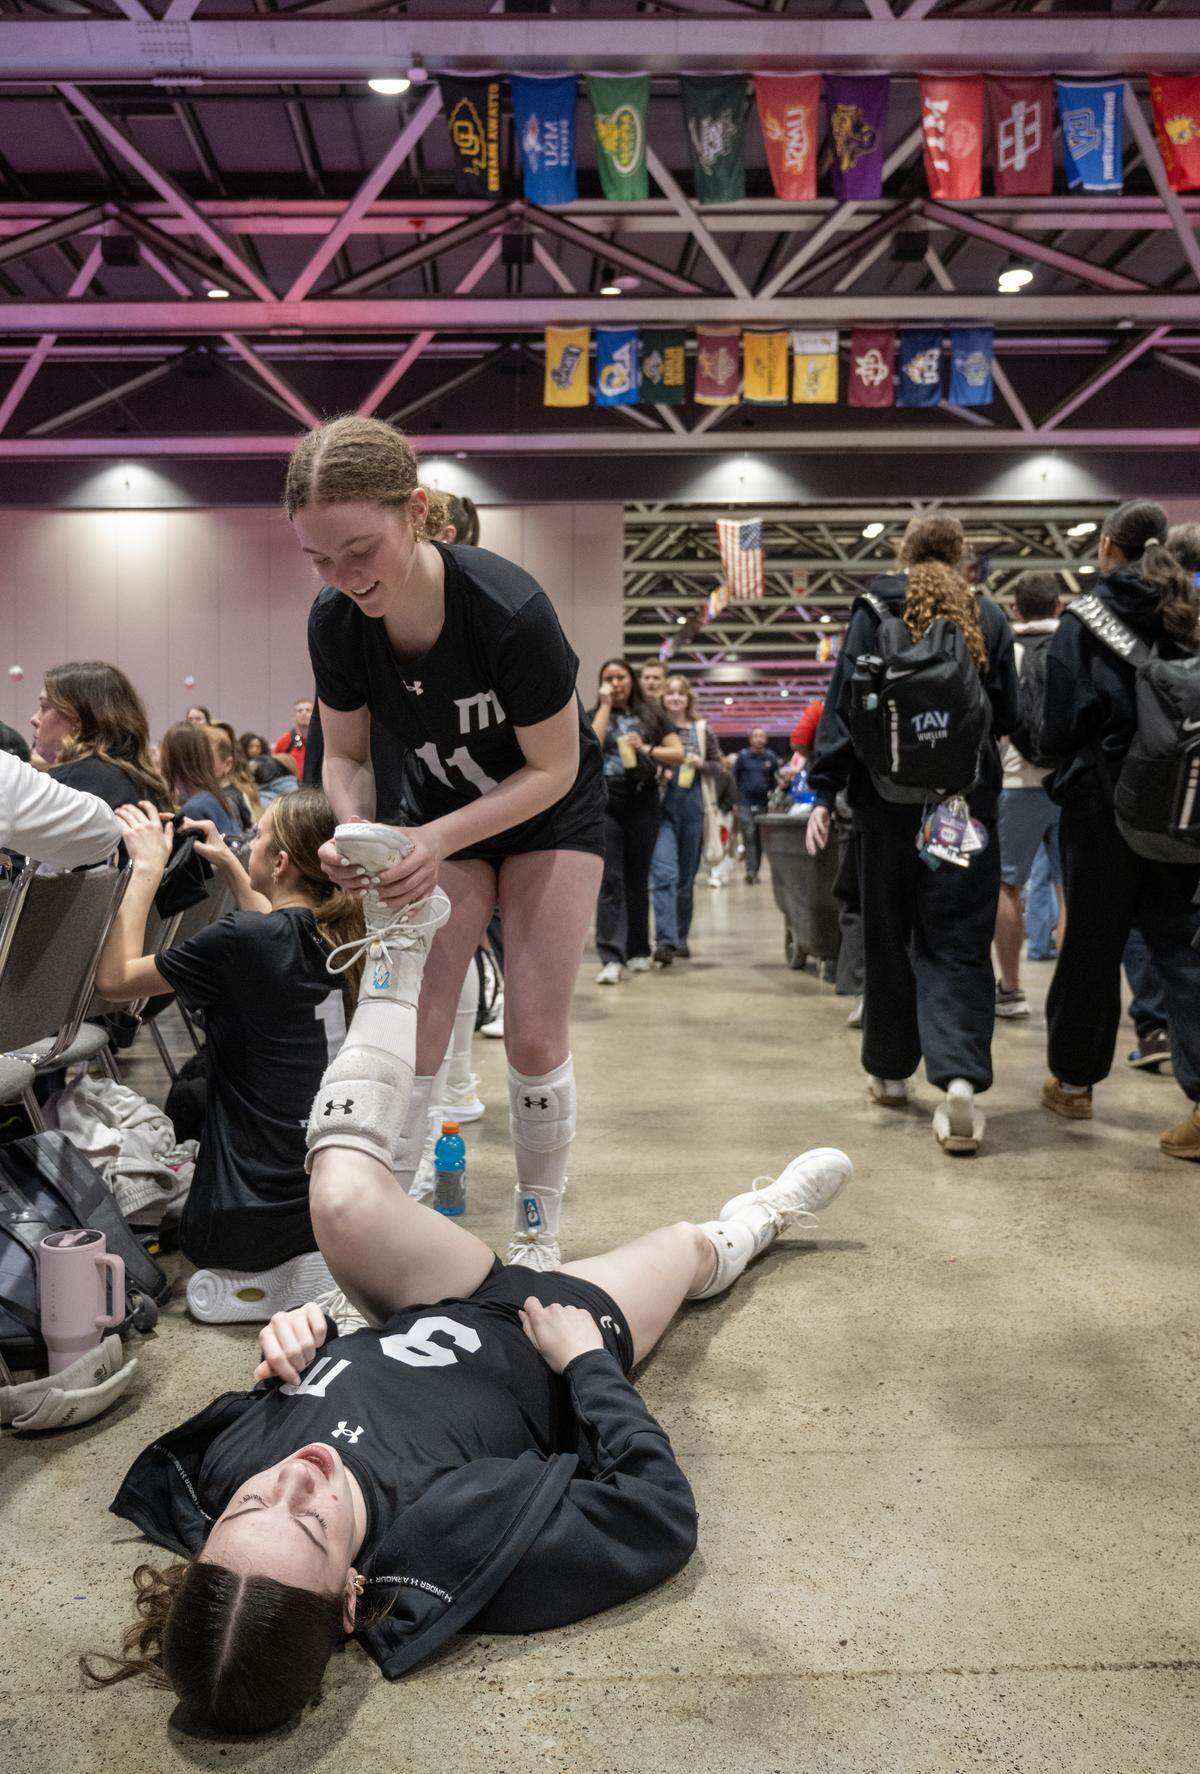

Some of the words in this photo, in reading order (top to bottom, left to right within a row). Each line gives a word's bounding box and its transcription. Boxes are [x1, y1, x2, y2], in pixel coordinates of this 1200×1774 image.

[911, 711, 950, 732] TAV
[414, 741, 498, 795] 11
[375, 1575, 410, 1583] ARMOUR
[420, 1580, 445, 1597] UNDER
